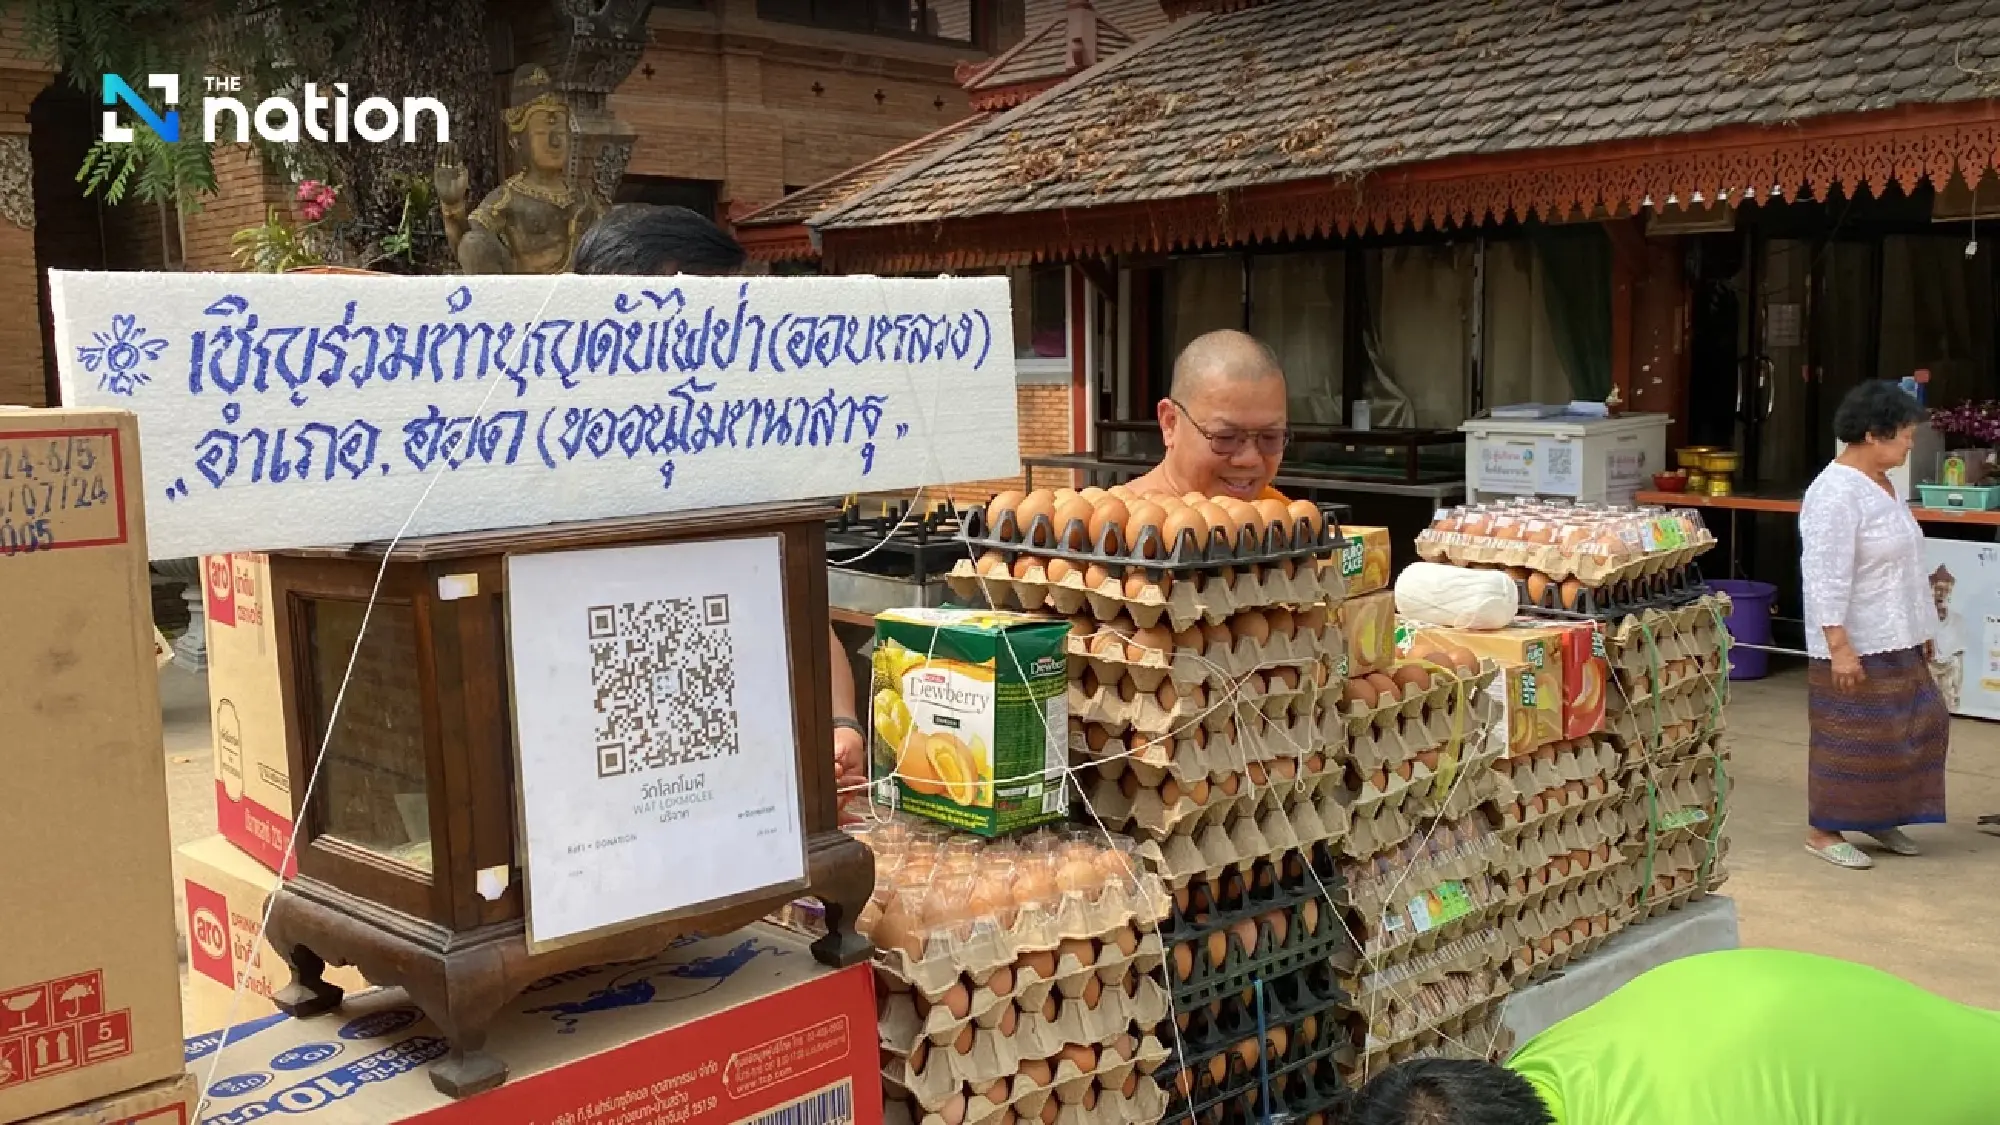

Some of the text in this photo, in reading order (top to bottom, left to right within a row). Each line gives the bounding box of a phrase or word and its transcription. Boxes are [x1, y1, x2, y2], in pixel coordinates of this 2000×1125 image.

[197, 916, 222, 951] aro
[98, 1021, 113, 1041] 5
[278, 1075, 355, 1112] 10
